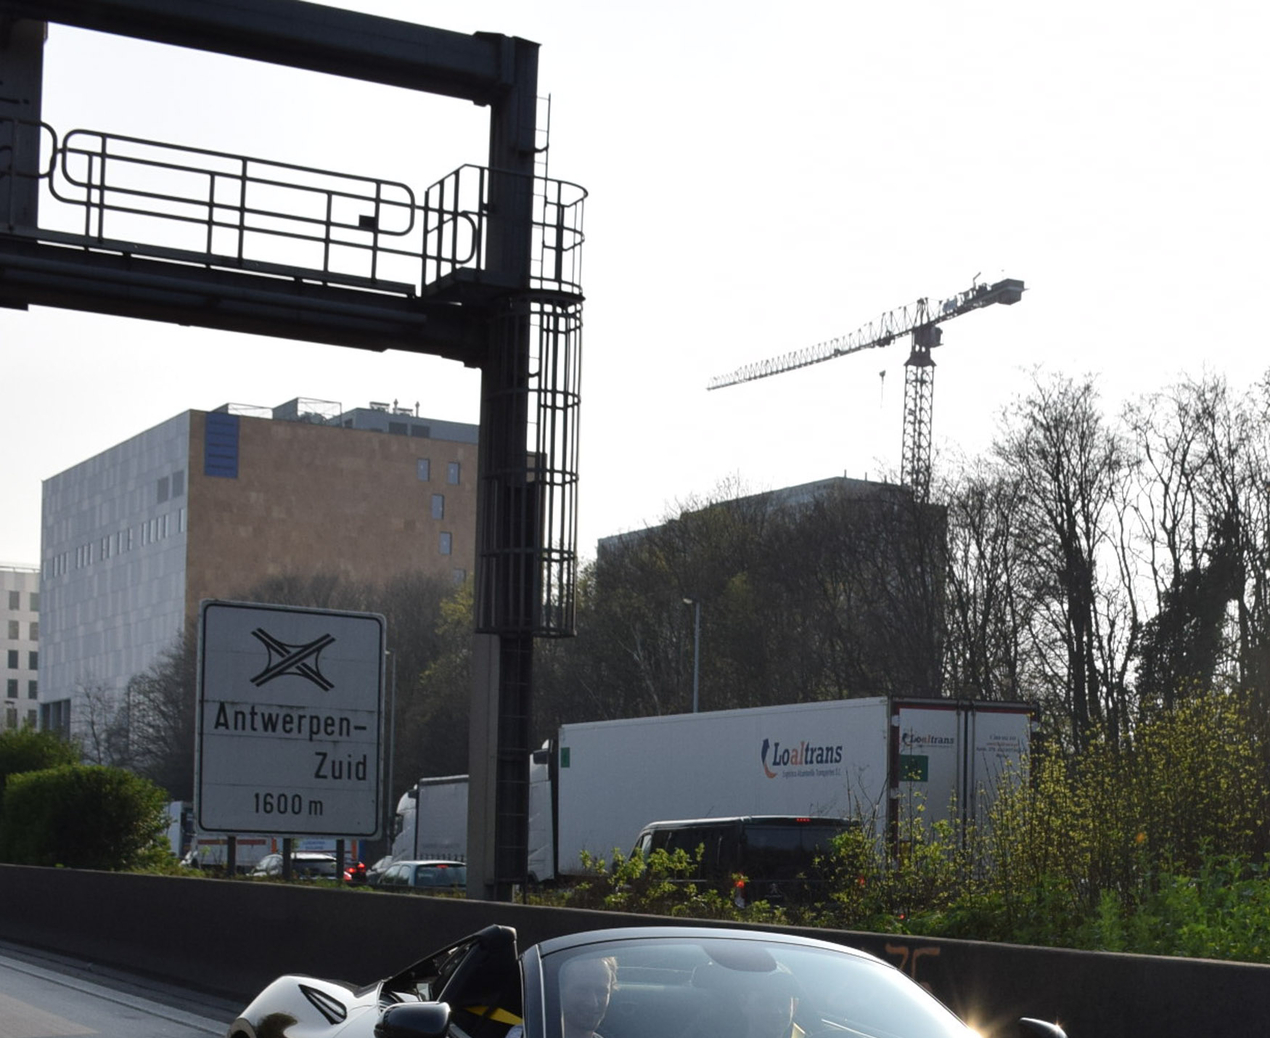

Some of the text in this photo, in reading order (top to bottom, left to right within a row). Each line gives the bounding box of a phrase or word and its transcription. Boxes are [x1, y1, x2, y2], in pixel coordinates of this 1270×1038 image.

[214, 701, 367, 742] Antwerpen-
[314, 752, 367, 781] Zuid
[772, 741, 843, 766] Loaltrans
[254, 792, 323, 816] 1600 m
